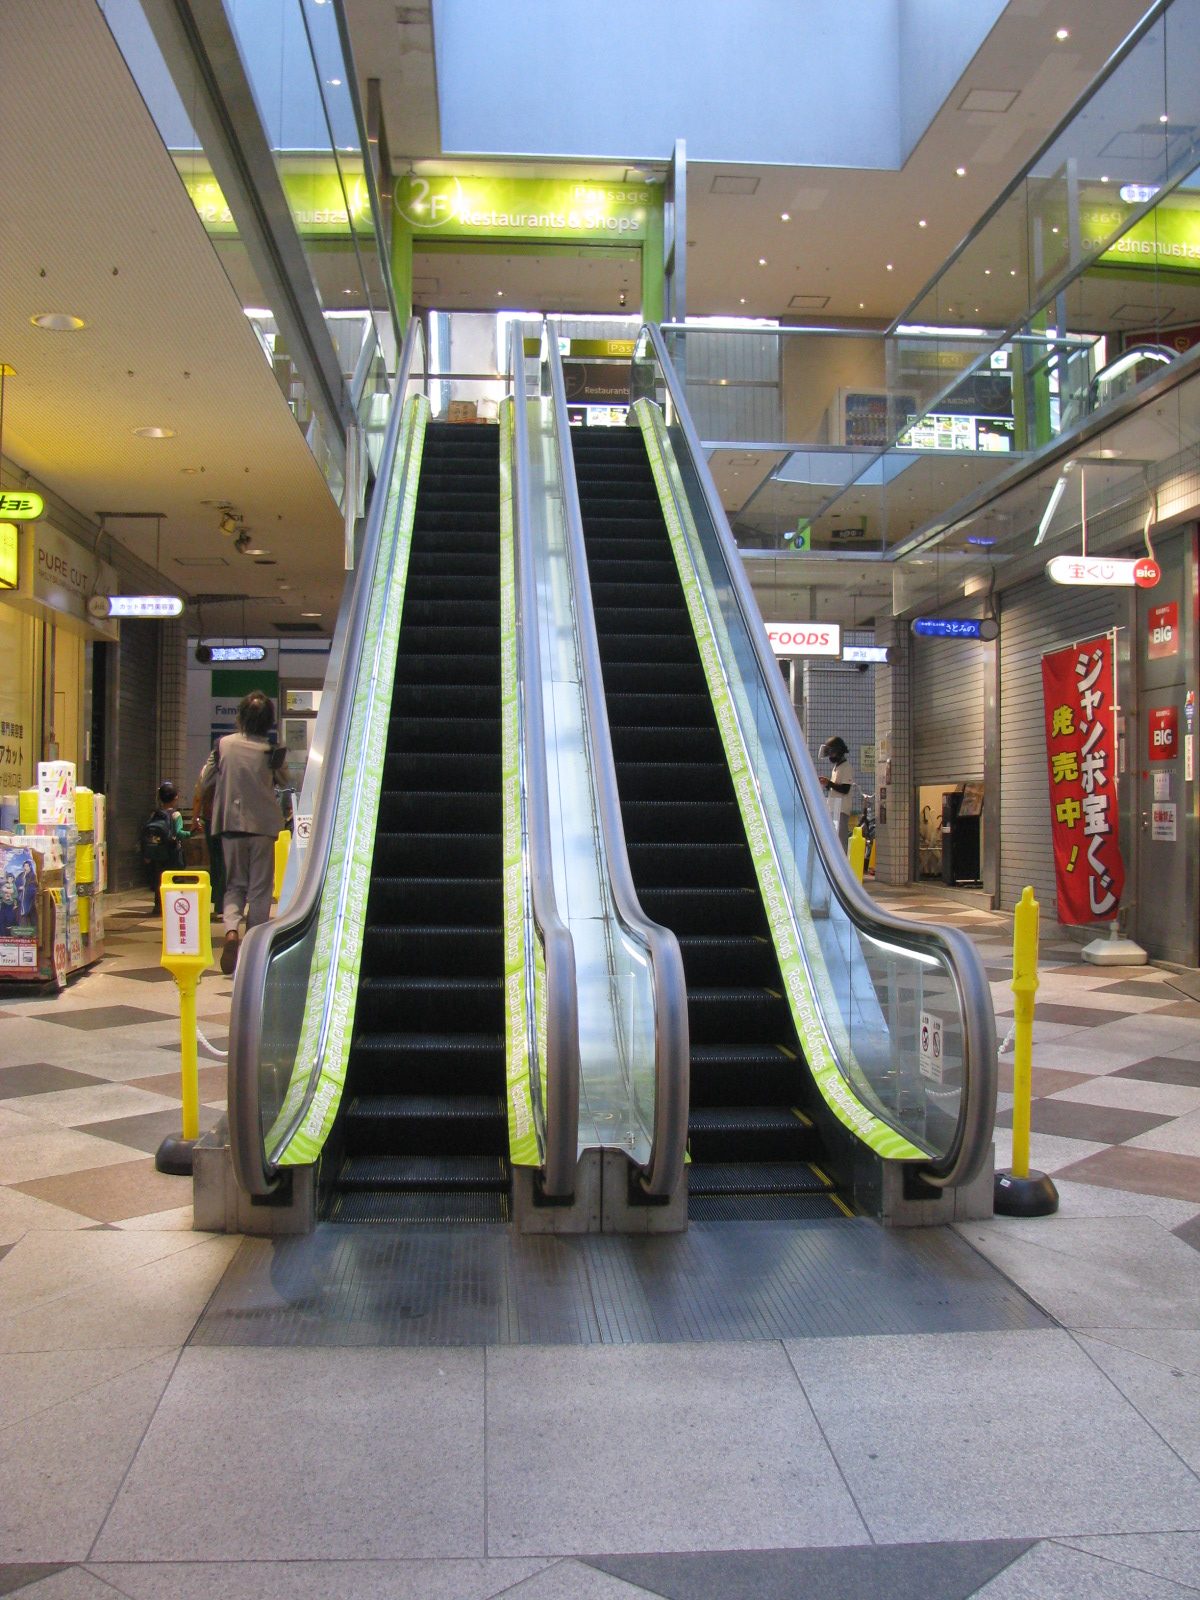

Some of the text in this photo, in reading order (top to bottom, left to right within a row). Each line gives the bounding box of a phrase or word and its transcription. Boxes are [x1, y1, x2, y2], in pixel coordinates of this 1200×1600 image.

[460, 209, 641, 234] Restaurants & Shops
[38, 548, 68, 578] PURE
[70, 567, 88, 591] CUT
[1068, 563, 1114, 580] 宝くじ
[768, 631, 831, 646] FOODS
[1153, 625, 1173, 645] BIG
[1153, 728, 1173, 747] BIG
[738, 774, 757, 823] Restaurants
[1074, 648, 1117, 916] ジャンボ宝くじ
[506, 863, 518, 919] Restaurants
[761, 862, 783, 921] Restaurants
[777, 925, 793, 961] Shops
[343, 900, 361, 959] Restaurants
[326, 1013, 346, 1073] Restaurants
[336, 970, 353, 1004] Shops
[507, 972, 522, 1033] Restaurants
[787, 968, 813, 1033] Restaurants
[809, 1036, 827, 1072] Shops
[511, 1046, 524, 1077] Shops
